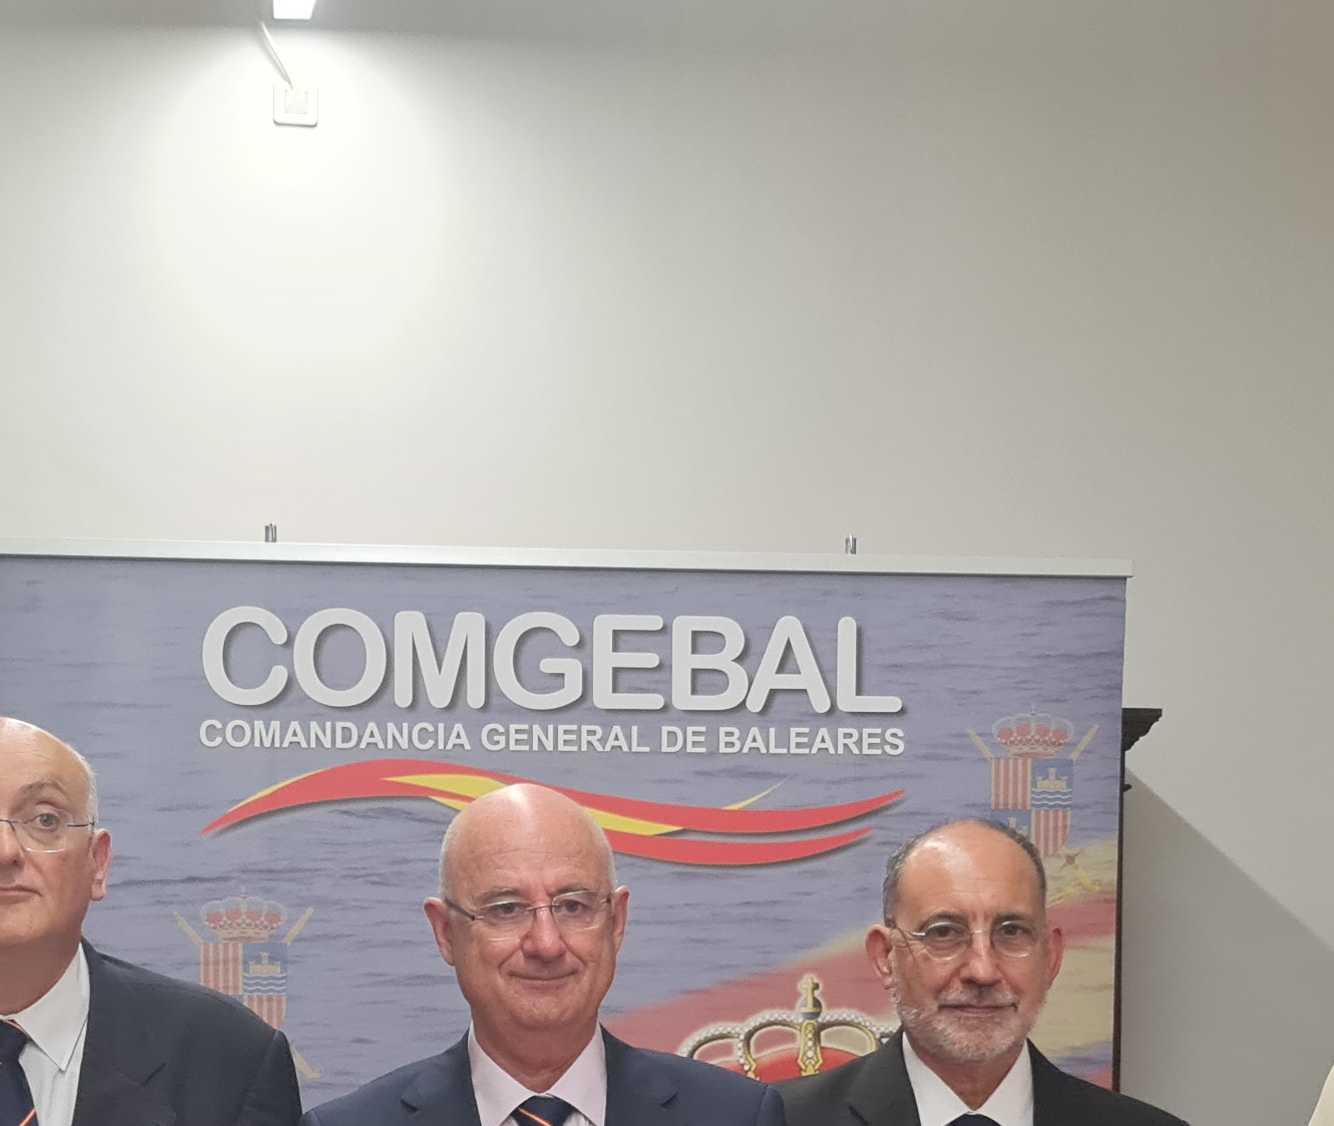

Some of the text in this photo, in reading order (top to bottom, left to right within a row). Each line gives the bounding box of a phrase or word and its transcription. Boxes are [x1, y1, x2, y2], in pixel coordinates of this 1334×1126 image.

[202, 606, 903, 714] COMGEBAL
[199, 719, 905, 756] COMANDANCIA GENERAL DE BALEARES
